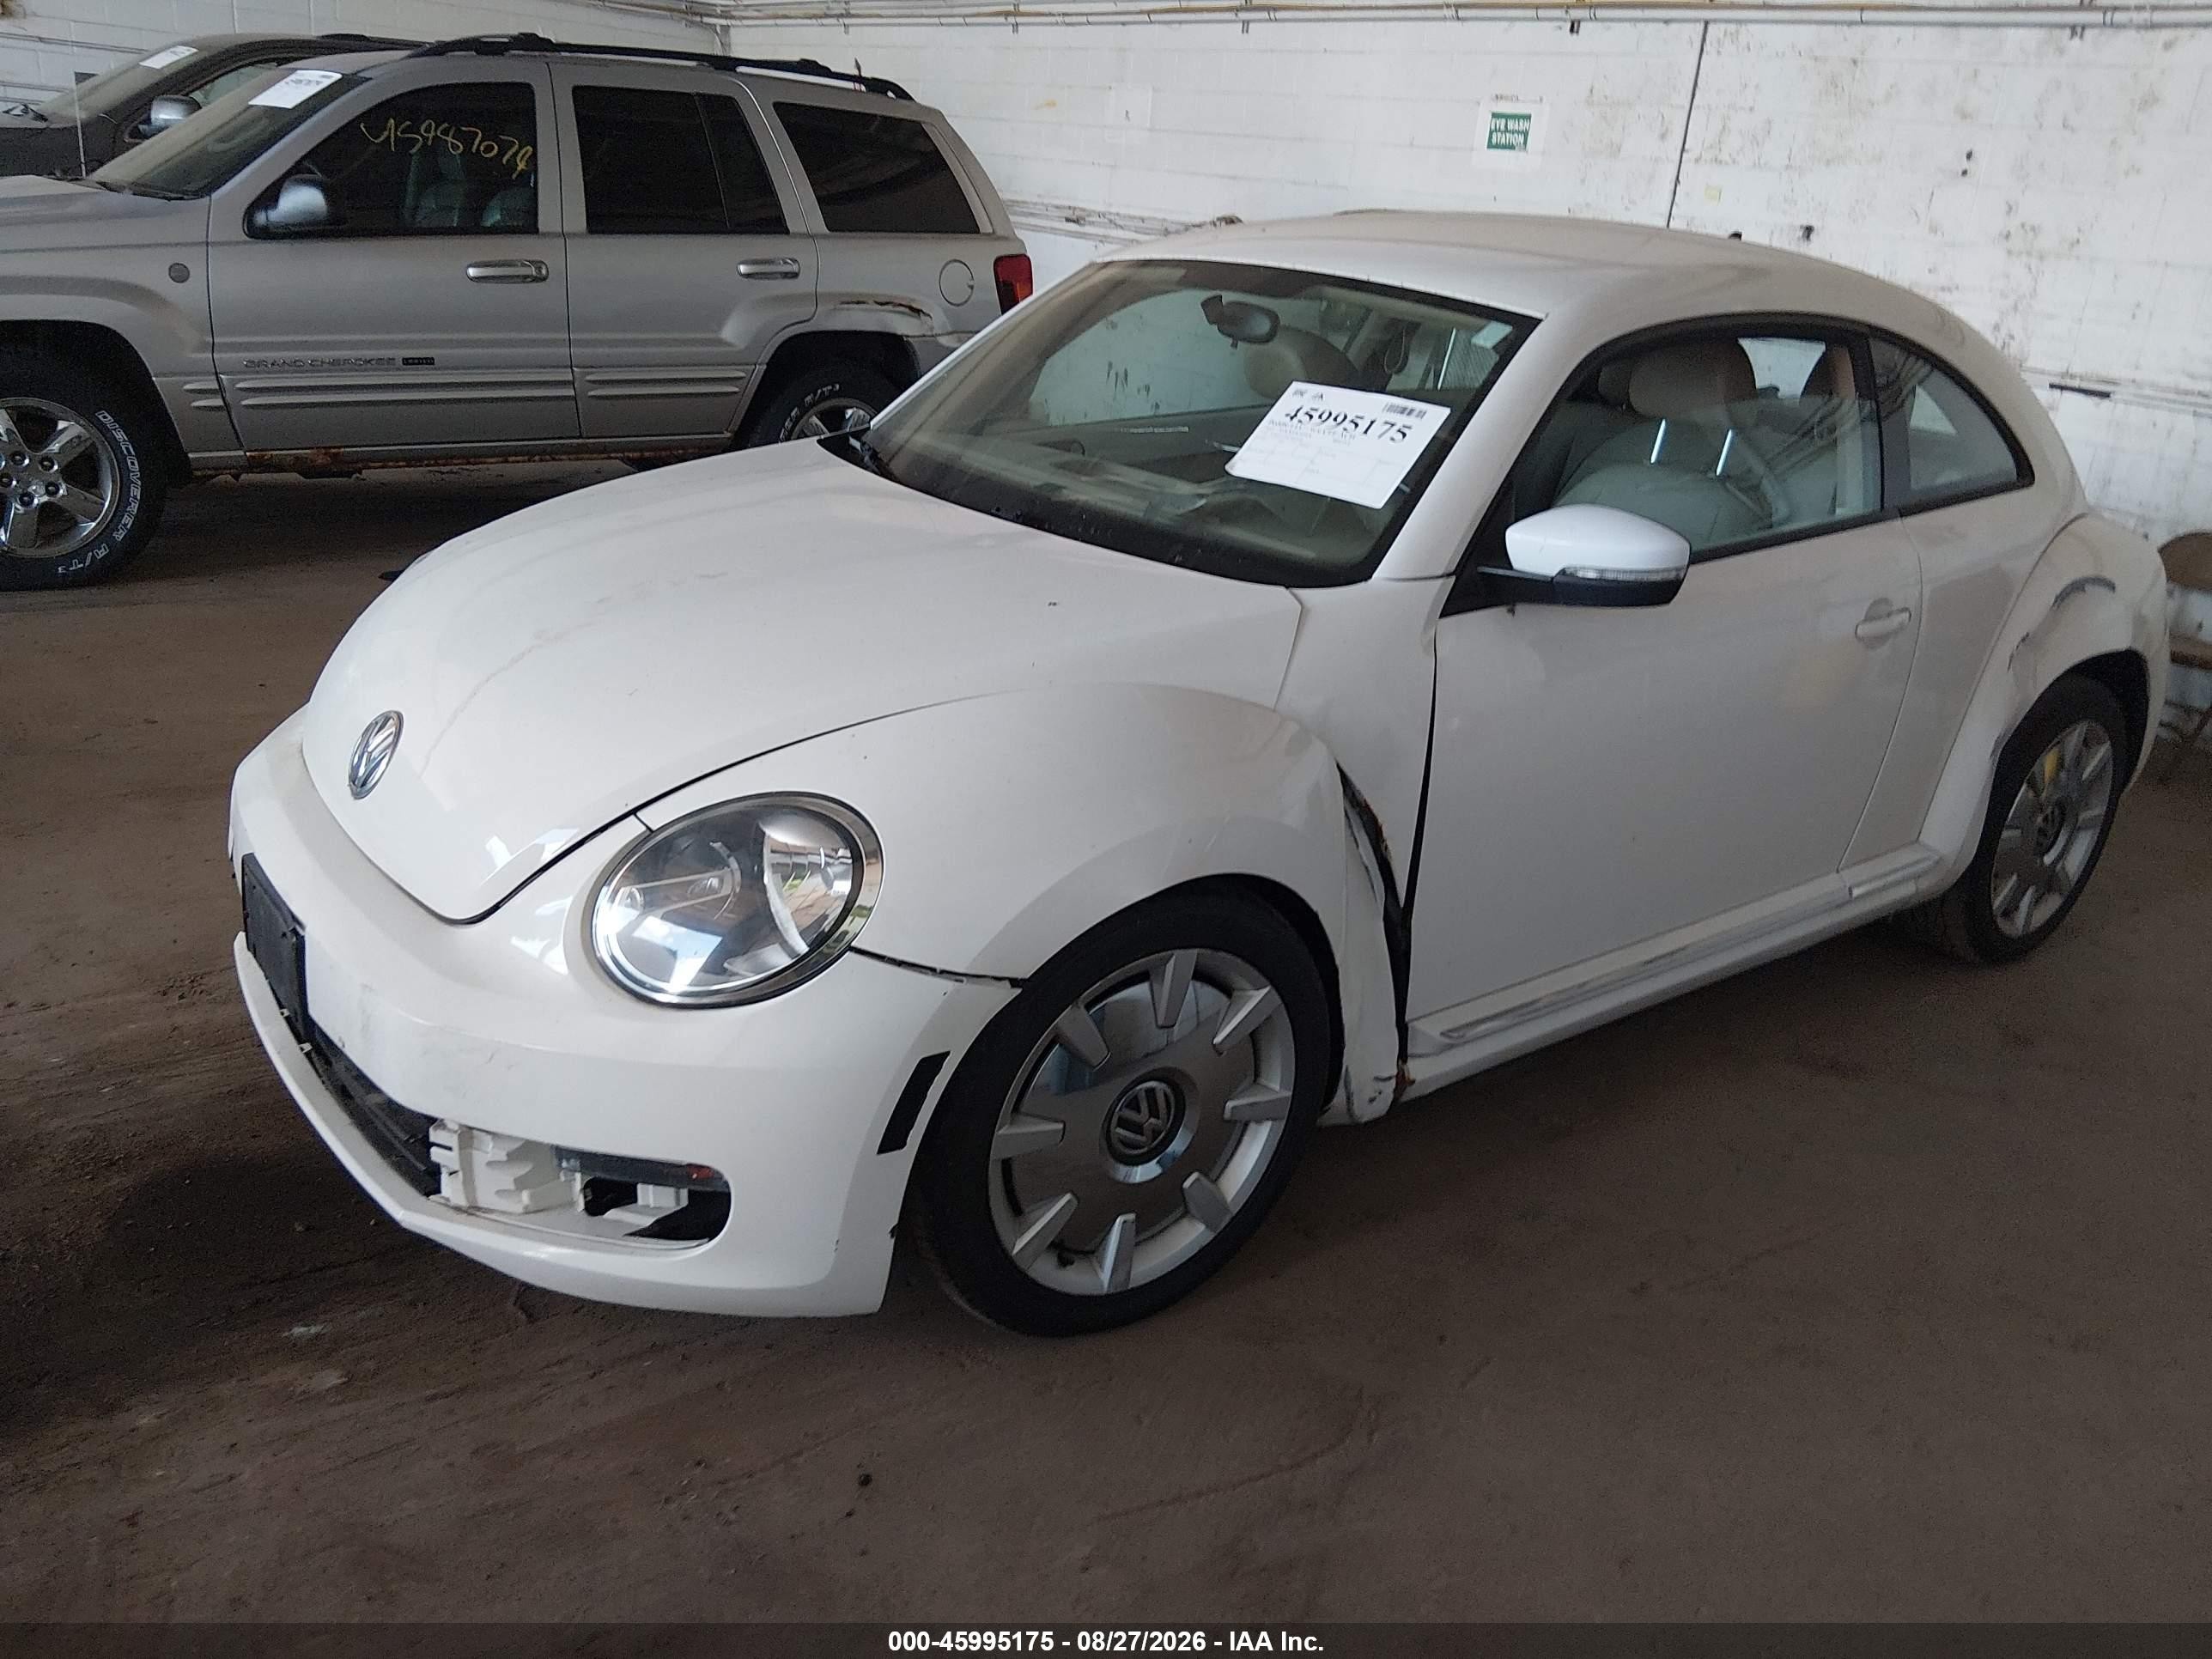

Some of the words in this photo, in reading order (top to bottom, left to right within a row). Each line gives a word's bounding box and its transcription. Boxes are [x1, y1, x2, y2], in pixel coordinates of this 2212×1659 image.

[1492, 131, 1525, 147] STATION
[243, 358, 305, 368] GRAND
[307, 357, 396, 367] CHEROKEE
[1285, 405, 1413, 444] 45995175
[95, 410, 141, 542] DISCOVERER
